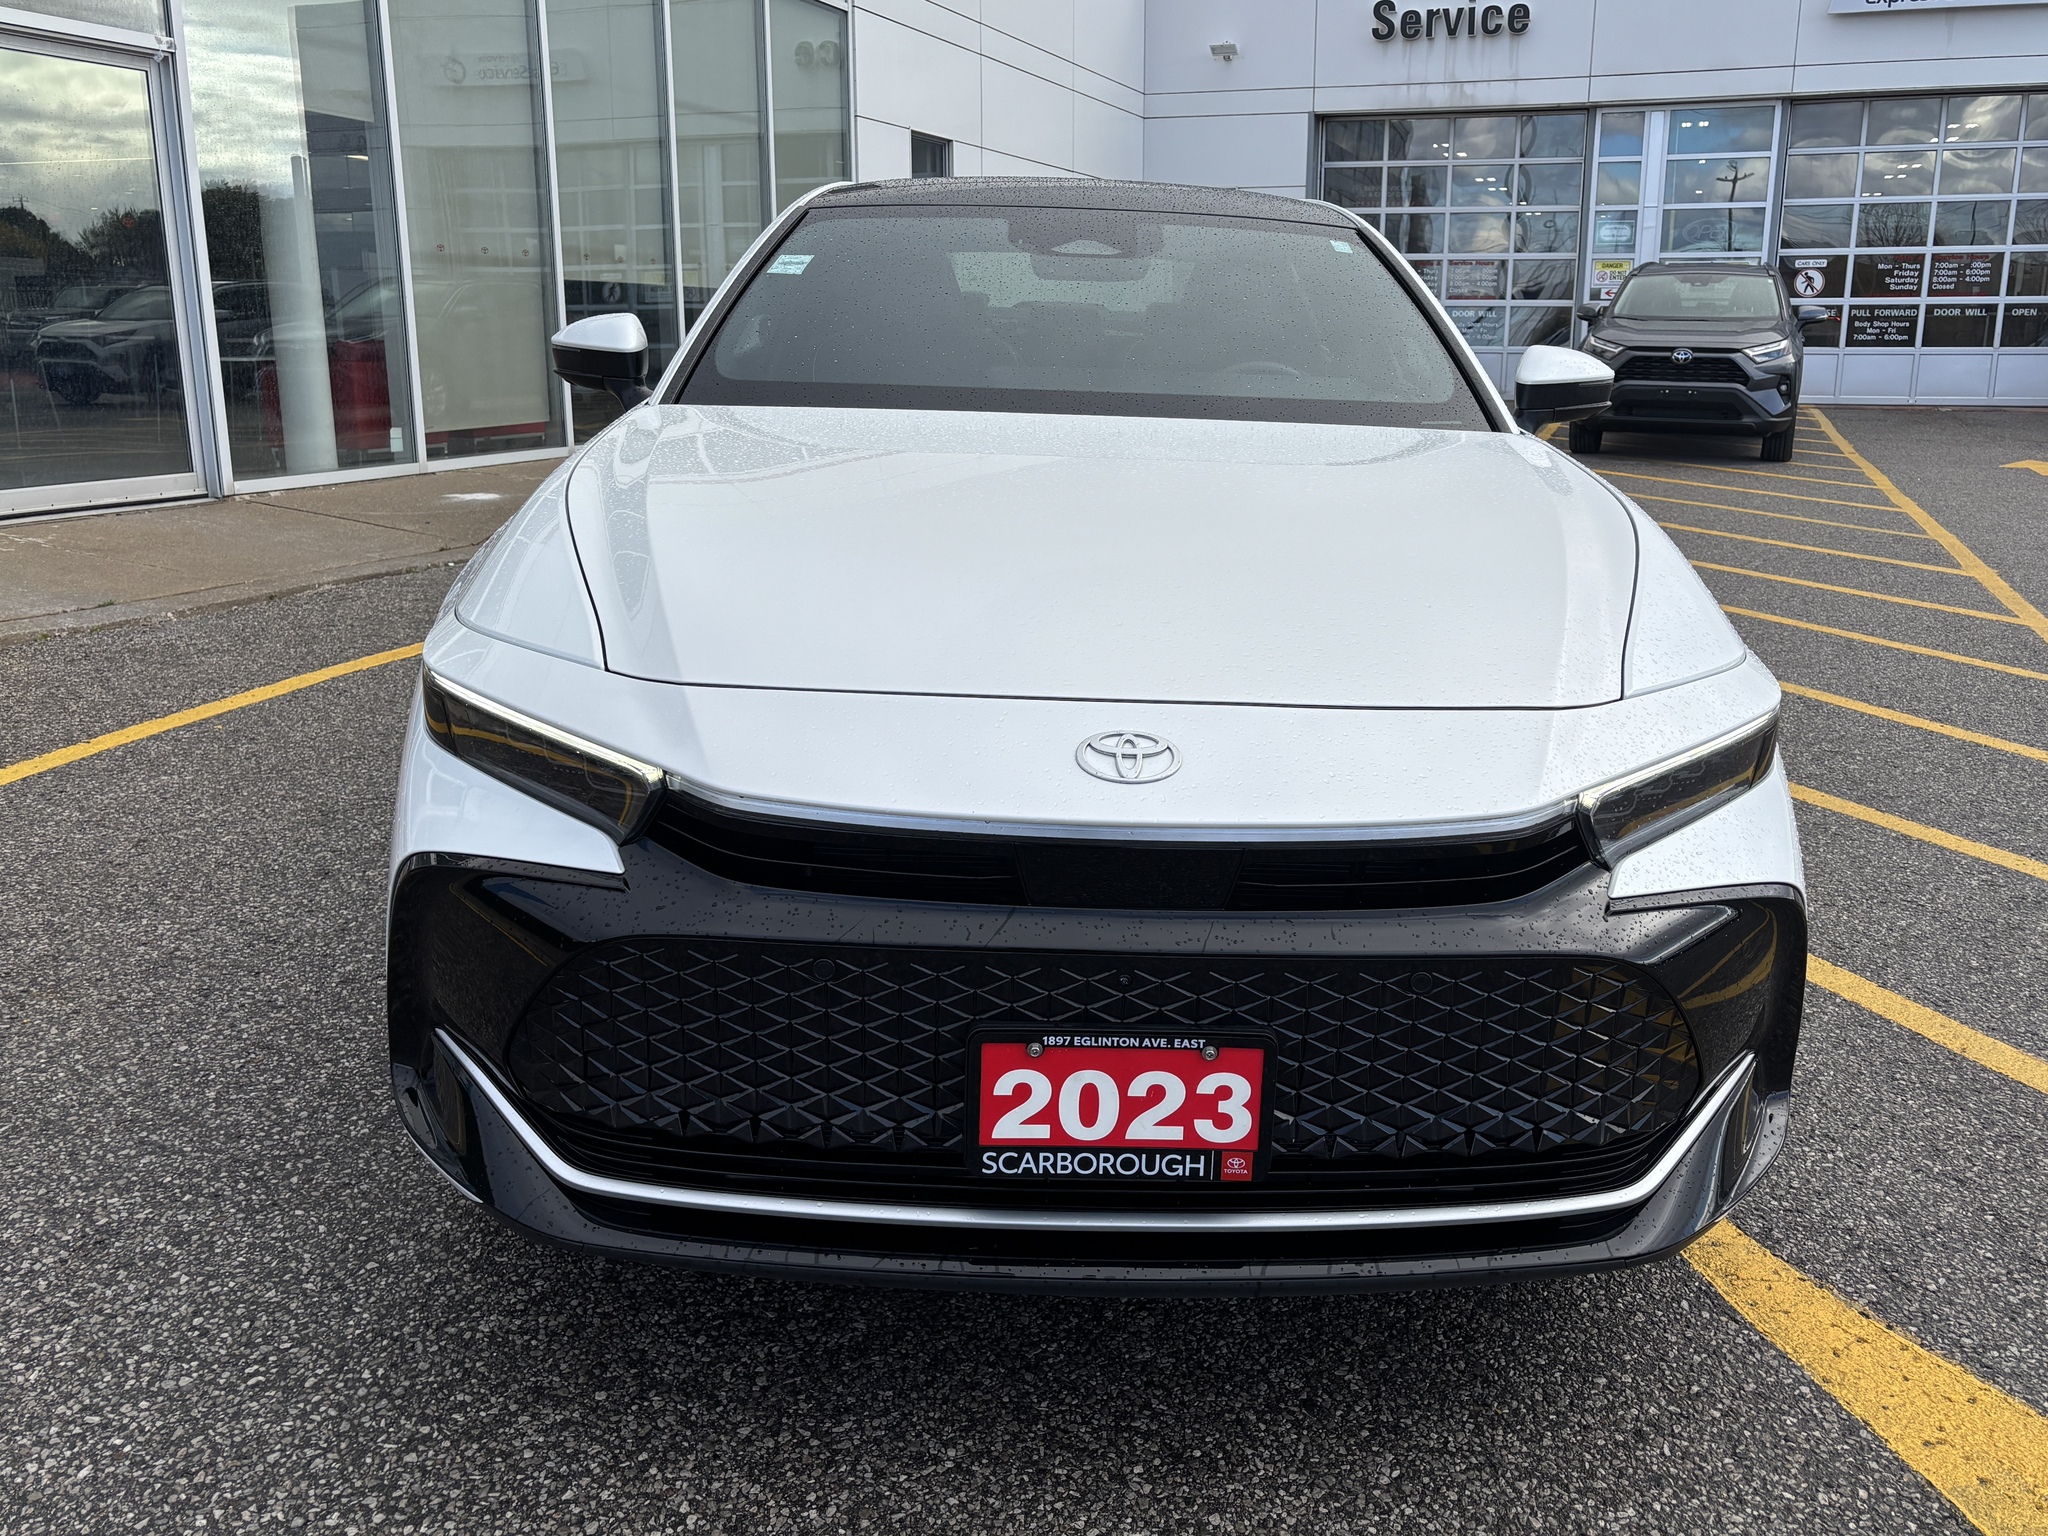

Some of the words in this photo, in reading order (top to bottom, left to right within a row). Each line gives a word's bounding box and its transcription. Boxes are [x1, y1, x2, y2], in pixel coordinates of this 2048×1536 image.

[1371, 0, 1531, 41] Service
[1884, 276, 1918, 284] Saturday
[1851, 309, 1871, 317] PULL
[1874, 308, 1918, 316] FORWARD
[1934, 308, 1961, 316] DOOR
[1966, 308, 1987, 316] WILL
[2011, 308, 2038, 316] OPEN
[1042, 1036, 1072, 1046] 1897
[1074, 1036, 1139, 1048] EGLINTON
[1142, 1037, 1171, 1048] AVE.
[1174, 1038, 1206, 1049] EAST
[991, 1068, 1252, 1144] 2023
[982, 1152, 1205, 1177] SCARBOROUGH
